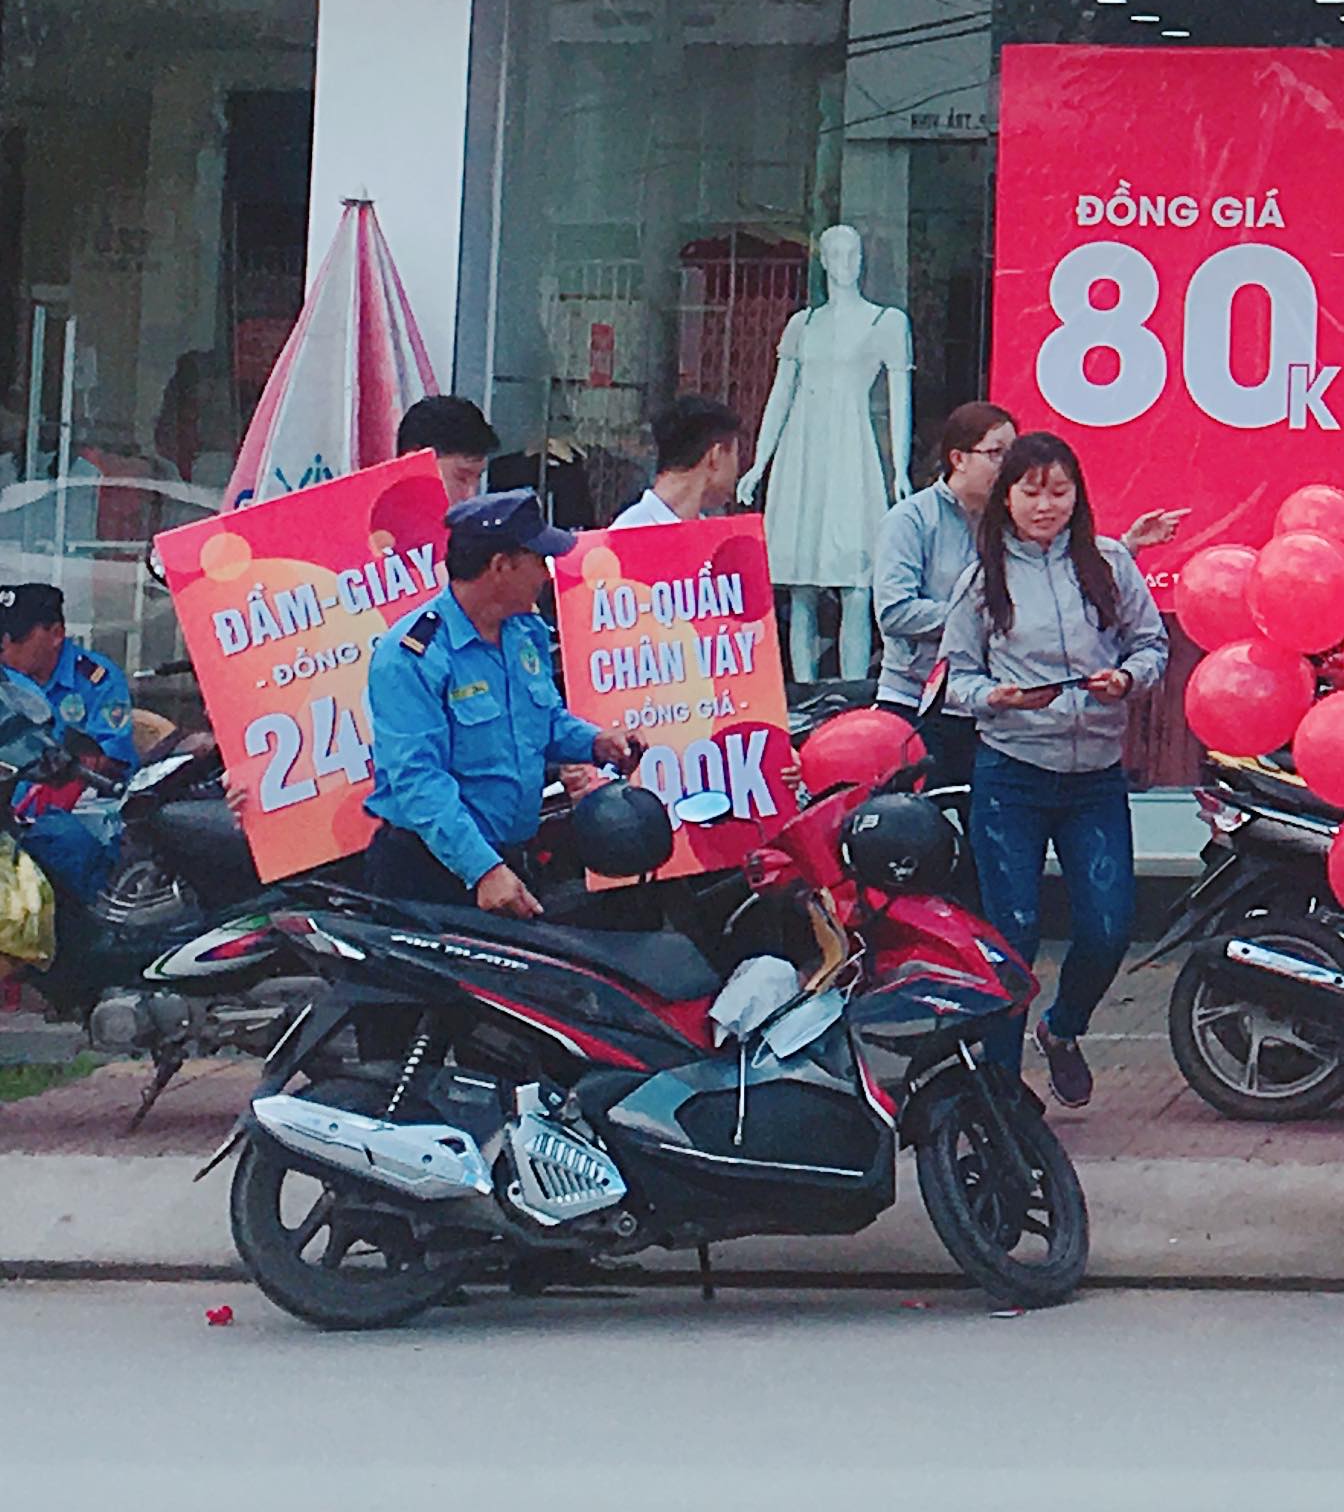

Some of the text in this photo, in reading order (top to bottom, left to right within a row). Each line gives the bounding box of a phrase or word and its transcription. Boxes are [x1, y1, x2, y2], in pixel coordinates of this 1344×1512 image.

[1076, 178, 1286, 228] ĐỒNG GIÁ
[1036, 240, 1342, 431] 80K
[213, 543, 441, 658] ĐẦM-GIÀY
[271, 646, 362, 689] ĐỒNG
[589, 630, 757, 696] CHÂN VÁY
[623, 689, 736, 730] ĐỒNG GIÁ
[243, 695, 375, 814] 24
